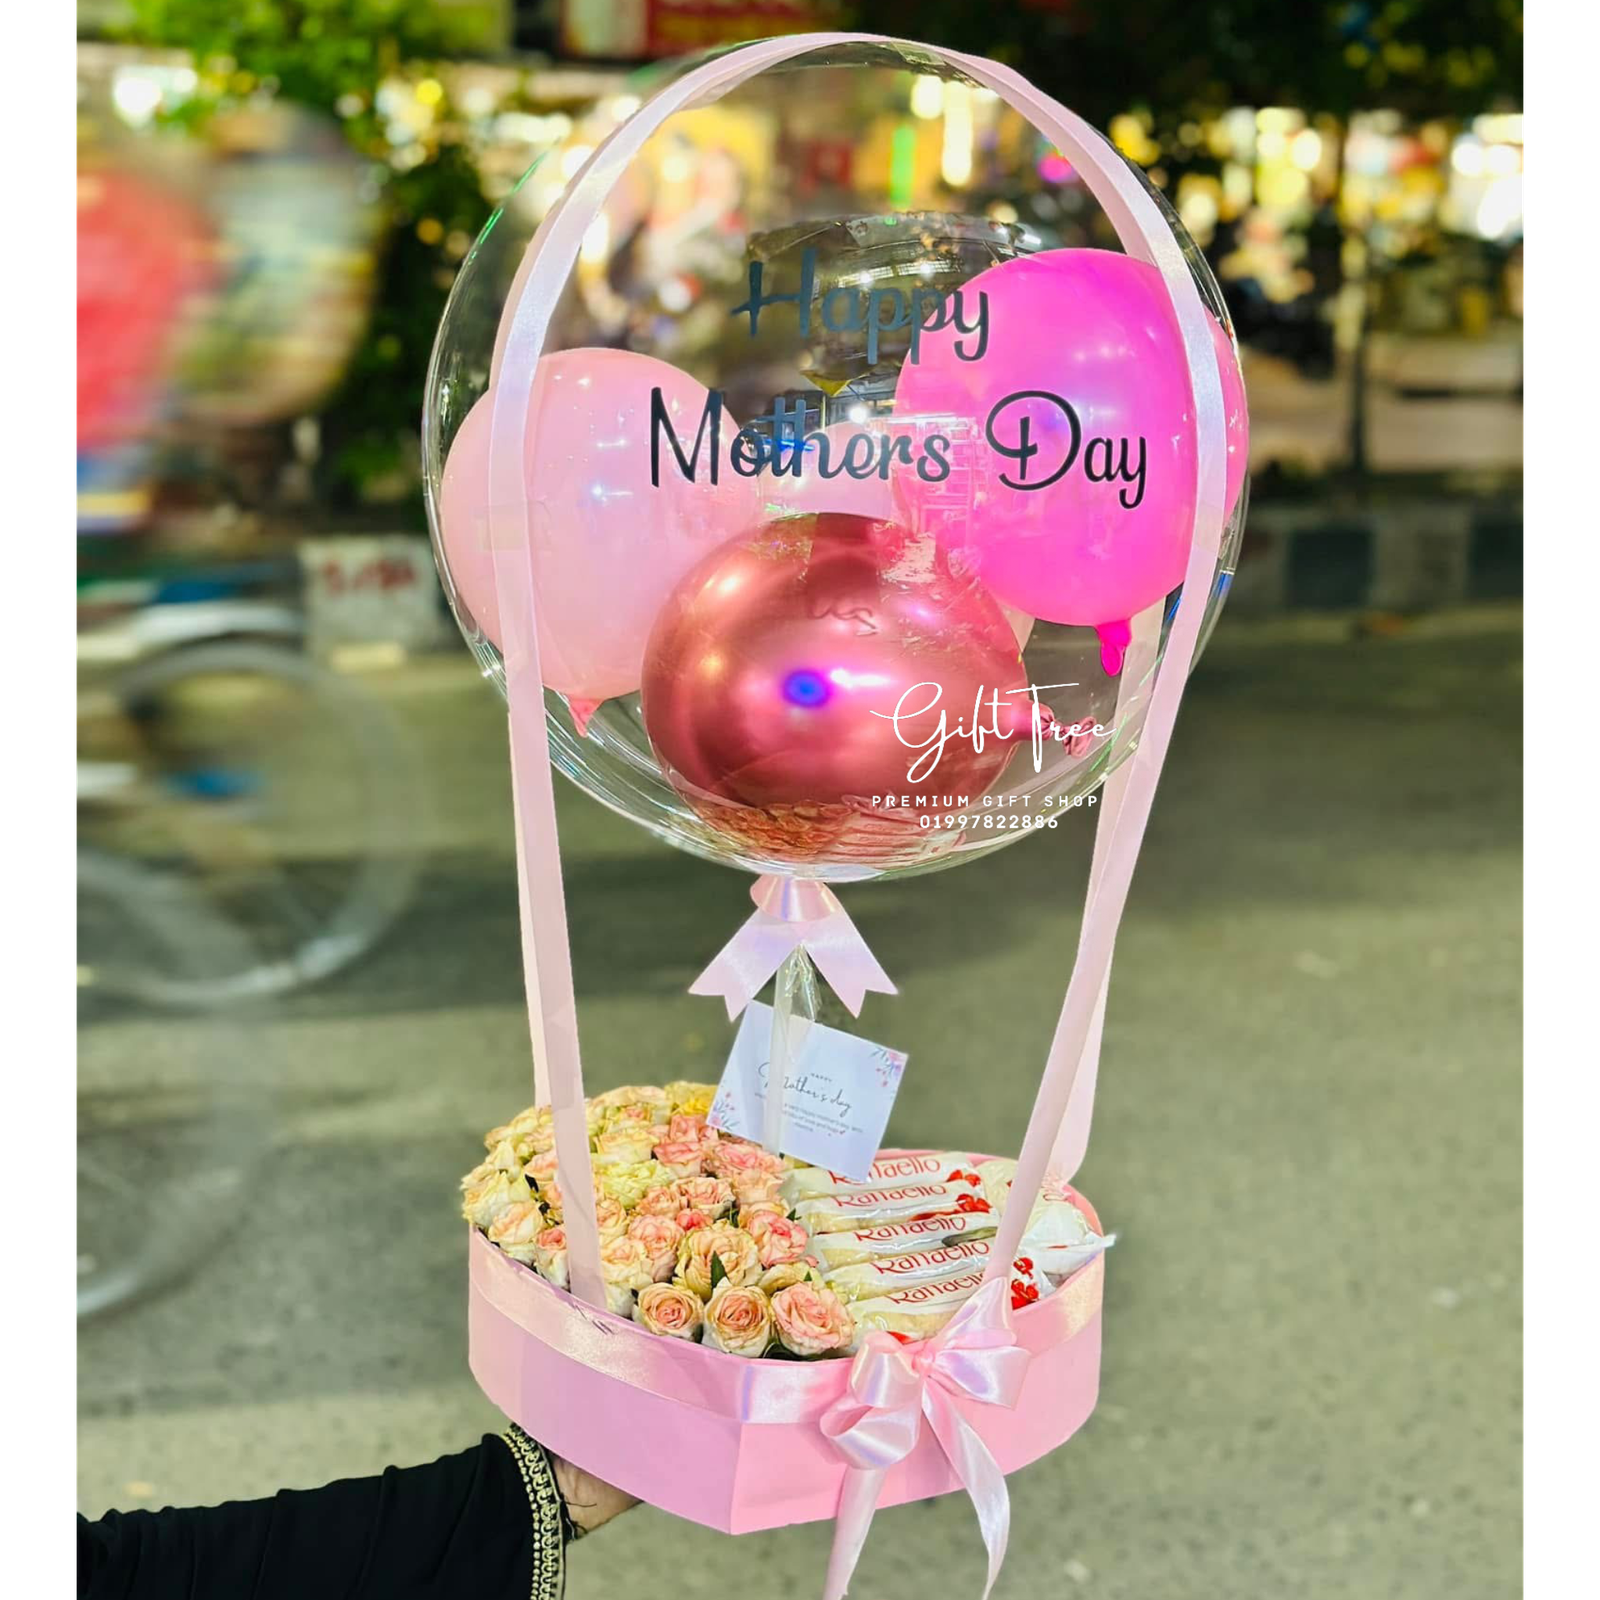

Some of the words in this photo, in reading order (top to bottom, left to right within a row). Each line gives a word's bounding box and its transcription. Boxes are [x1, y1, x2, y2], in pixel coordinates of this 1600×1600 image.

[731, 247, 989, 365] Happy
[650, 386, 951, 488] Mothers
[985, 390, 1147, 509] Day
[827, 1156, 941, 1186] Rfaello
[884, 1272, 984, 1304] Raffaell
